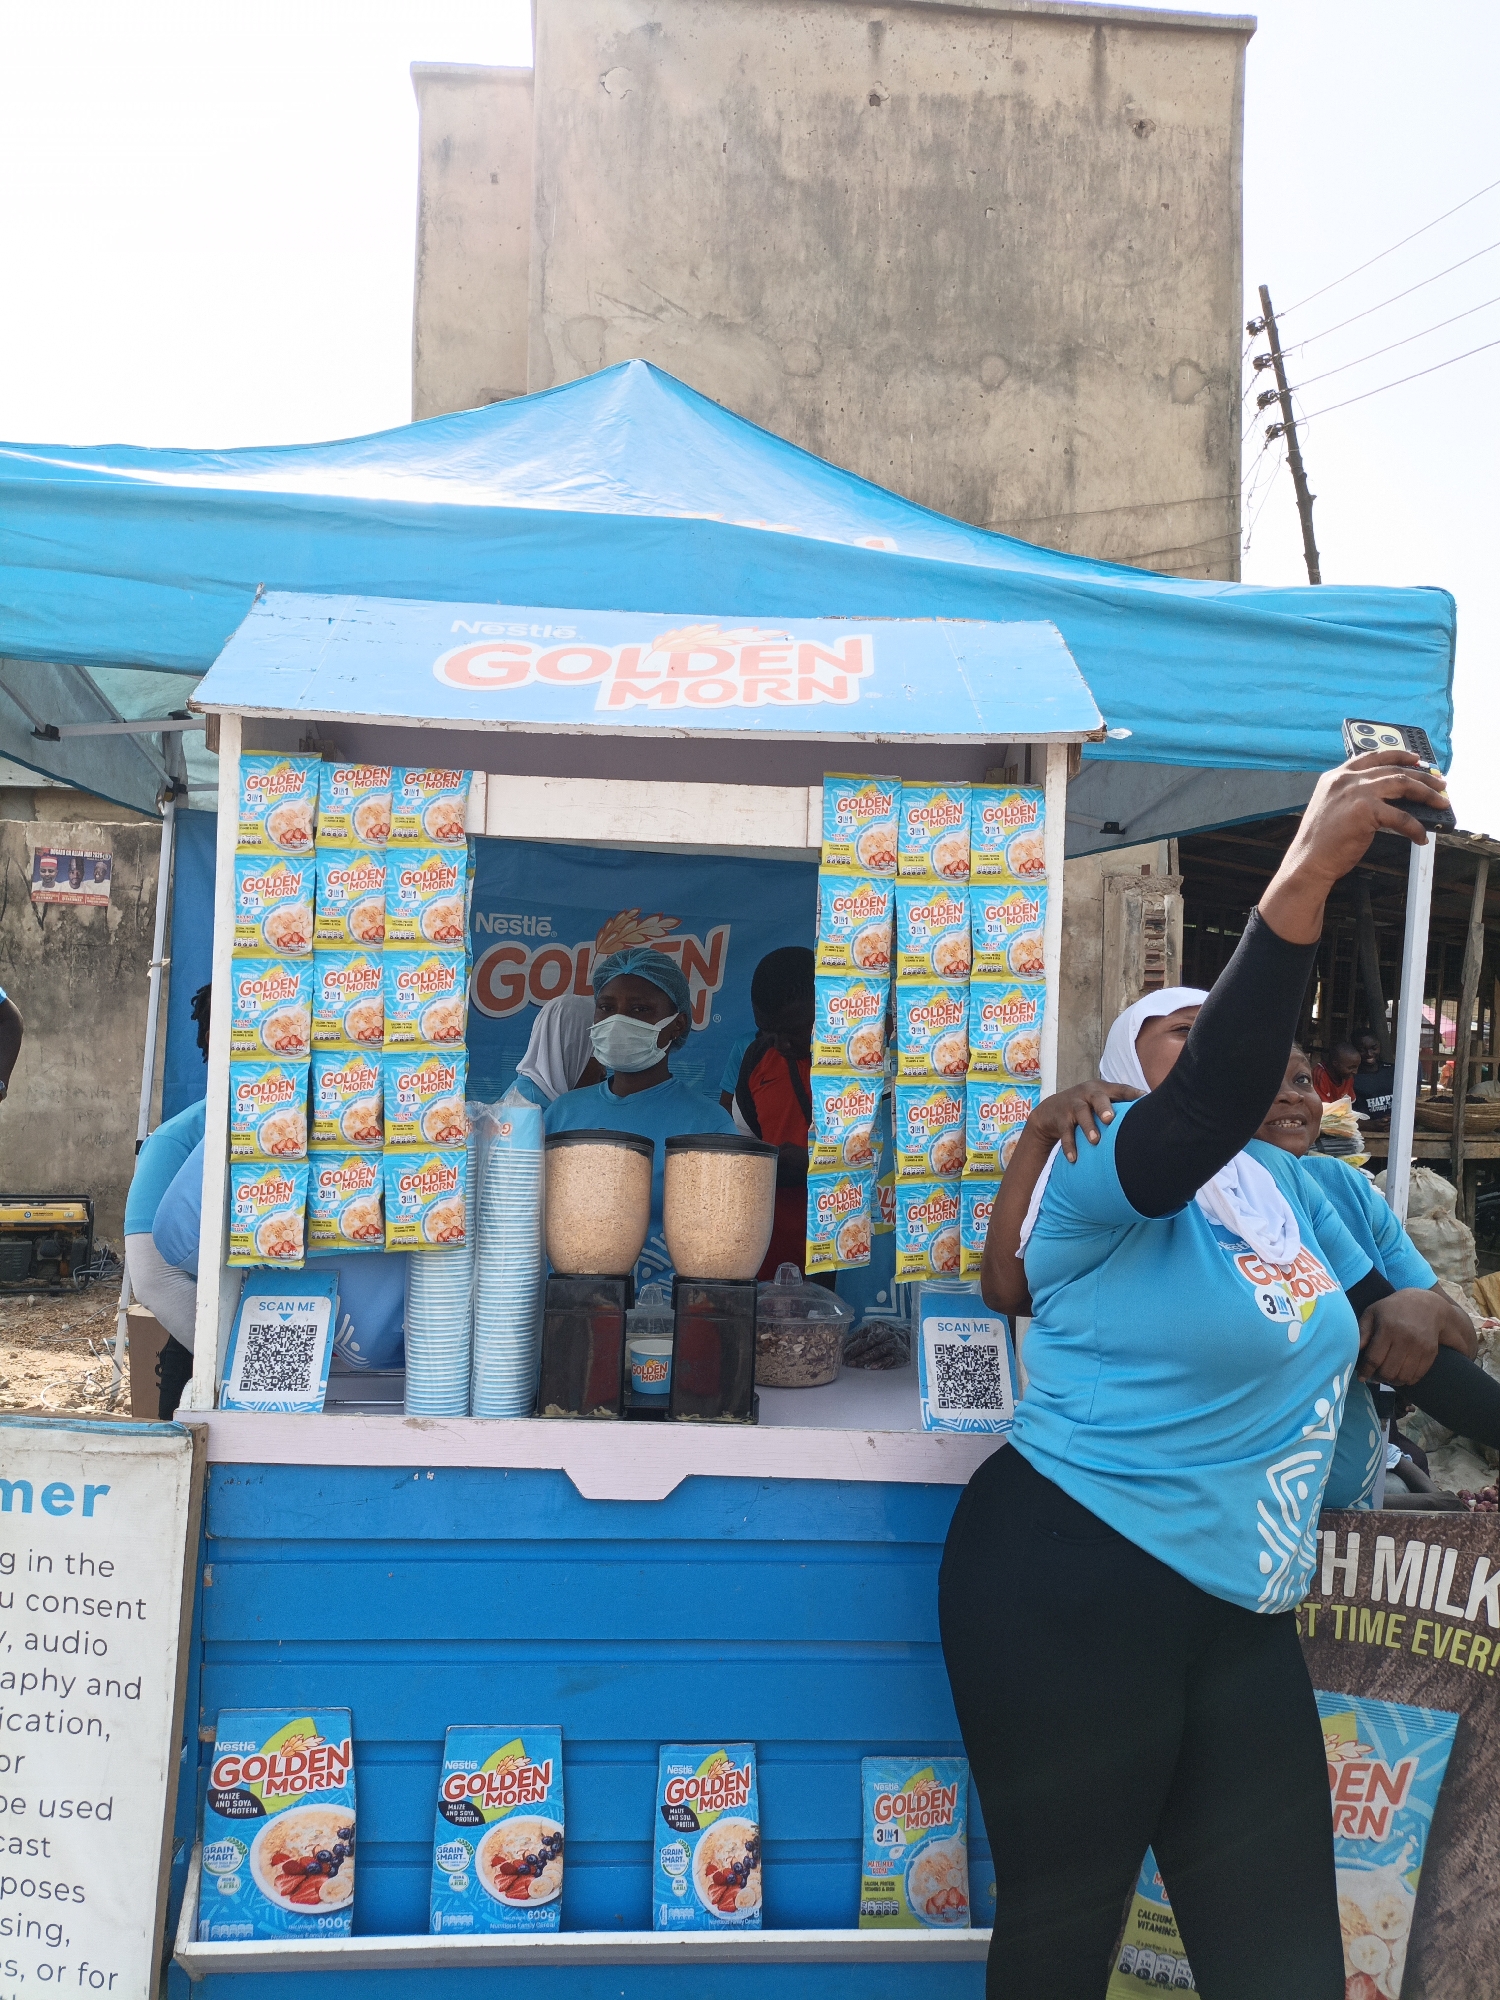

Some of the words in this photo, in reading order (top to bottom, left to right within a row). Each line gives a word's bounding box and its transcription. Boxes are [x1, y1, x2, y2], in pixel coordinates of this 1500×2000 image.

[444, 639, 862, 686] GOLDEN
[608, 676, 848, 705] MORN
[247, 771, 305, 789] GOLDEN
[333, 767, 391, 783] GOLDEN
[354, 777, 388, 788] MORN
[405, 770, 462, 785] GOLDEN
[424, 778, 458, 789] MORN
[267, 784, 301, 796] MORN
[838, 795, 891, 812] GOLDEN
[857, 806, 889, 817] MORN
[909, 802, 962, 823] GOLDEN
[983, 802, 1036, 823] GOLDEN
[929, 815, 960, 828] MORN
[1004, 814, 1034, 826] MORN
[242, 872, 301, 890] GOLDEN
[328, 867, 386, 885] GOLDEN
[401, 866, 457, 885] GOLDEN
[264, 886, 298, 898] MORN
[349, 879, 383, 891] MORN
[422, 880, 454, 891] MORN
[834, 894, 887, 912] GOLDEN
[852, 905, 884, 917] MORN
[910, 902, 963, 922] GOLDEN
[986, 901, 1039, 921] GOLDEN
[930, 914, 961, 927] MORN
[1006, 912, 1036, 924] MORN
[325, 967, 382, 986] GOLDEN
[398, 966, 455, 988] GOLDEN
[477, 932, 724, 1012] GOLN
[240, 976, 299, 995] GOLDEN
[345, 981, 378, 992] MORN
[419, 982, 452, 993] MORN
[261, 990, 295, 1001] MORN
[829, 994, 880, 1014] GOLDEN
[847, 1007, 877, 1018] MORN
[910, 1002, 963, 1023] GOLDEN
[982, 1002, 1036, 1021] GOLDEN
[1003, 1013, 1033, 1025] MORN
[929, 1015, 960, 1028] MORN
[322, 1066, 377, 1088] GOLDEN
[398, 1068, 454, 1089] GOLDEN
[238, 1079, 295, 1100] GOLDEN
[342, 1081, 374, 1093] MORN
[420, 1081, 452, 1093] MORN
[260, 1092, 292, 1104] MORN
[825, 1093, 874, 1113] GOLDEN
[843, 1105, 873, 1116] MORN
[908, 1101, 961, 1122] GOLDEN
[980, 1101, 1031, 1119] GOLDEN
[1000, 1112, 1030, 1124] MORN
[928, 1113, 958, 1126] MORN
[320, 1165, 376, 1186] GOLDEN
[400, 1165, 457, 1190] GOLDEN
[238, 1180, 293, 1200] GOLDEN
[341, 1179, 372, 1191] MORN
[422, 1182, 454, 1194] MORN
[259, 1194, 290, 1206] MORN
[818, 1185, 862, 1211] GOLDEN
[836, 1200, 861, 1214] MORN
[908, 1197, 958, 1220] GOLDEN
[927, 1211, 956, 1224] MORN
[259, 1302, 294, 1311] SCAN
[298, 1302, 315, 1311] ME
[938, 1322, 970, 1332] SCAN
[974, 1323, 990, 1332] ME
[642, 1373, 665, 1381] MORN
[29, 1549, 52, 1572] in
[66, 1552, 115, 1578] the
[1370, 1535, 1500, 1629] MILK
[26, 1593, 147, 1620] consent
[25, 1630, 108, 1656] audio
[1331, 1605, 1406, 1649] TIME
[1411, 1618, 1500, 1676] EVER!
[87, 1677, 141, 1700] and
[213, 1740, 350, 1788] GOLDEN
[265, 1769, 344, 1795] MORN
[444, 1762, 550, 1800] GOLDEN
[667, 1766, 750, 1803] GOLDEN
[215, 1800, 230, 1808] AND
[218, 1792, 240, 1800] MAIZE
[485, 1786, 544, 1806] MORN
[700, 1790, 746, 1811] MORN
[876, 1784, 956, 1821] GOLDEN
[39, 1797, 113, 1821] used
[906, 1809, 951, 1828] MORN
[1333, 1804, 1389, 1836] RN
[203, 1854, 234, 1862] SMART
[204, 1846, 234, 1854] GRAIN
[662, 1848, 684, 1856] GRAIN
[662, 1856, 684, 1864] SMART
[0, 1876, 85, 1903] poses
[528, 1910, 556, 1921] 600g
[1138, 1920, 1177, 1937] VITAMINS
[37, 1964, 67, 1983] or
[78, 1962, 118, 1991] for
